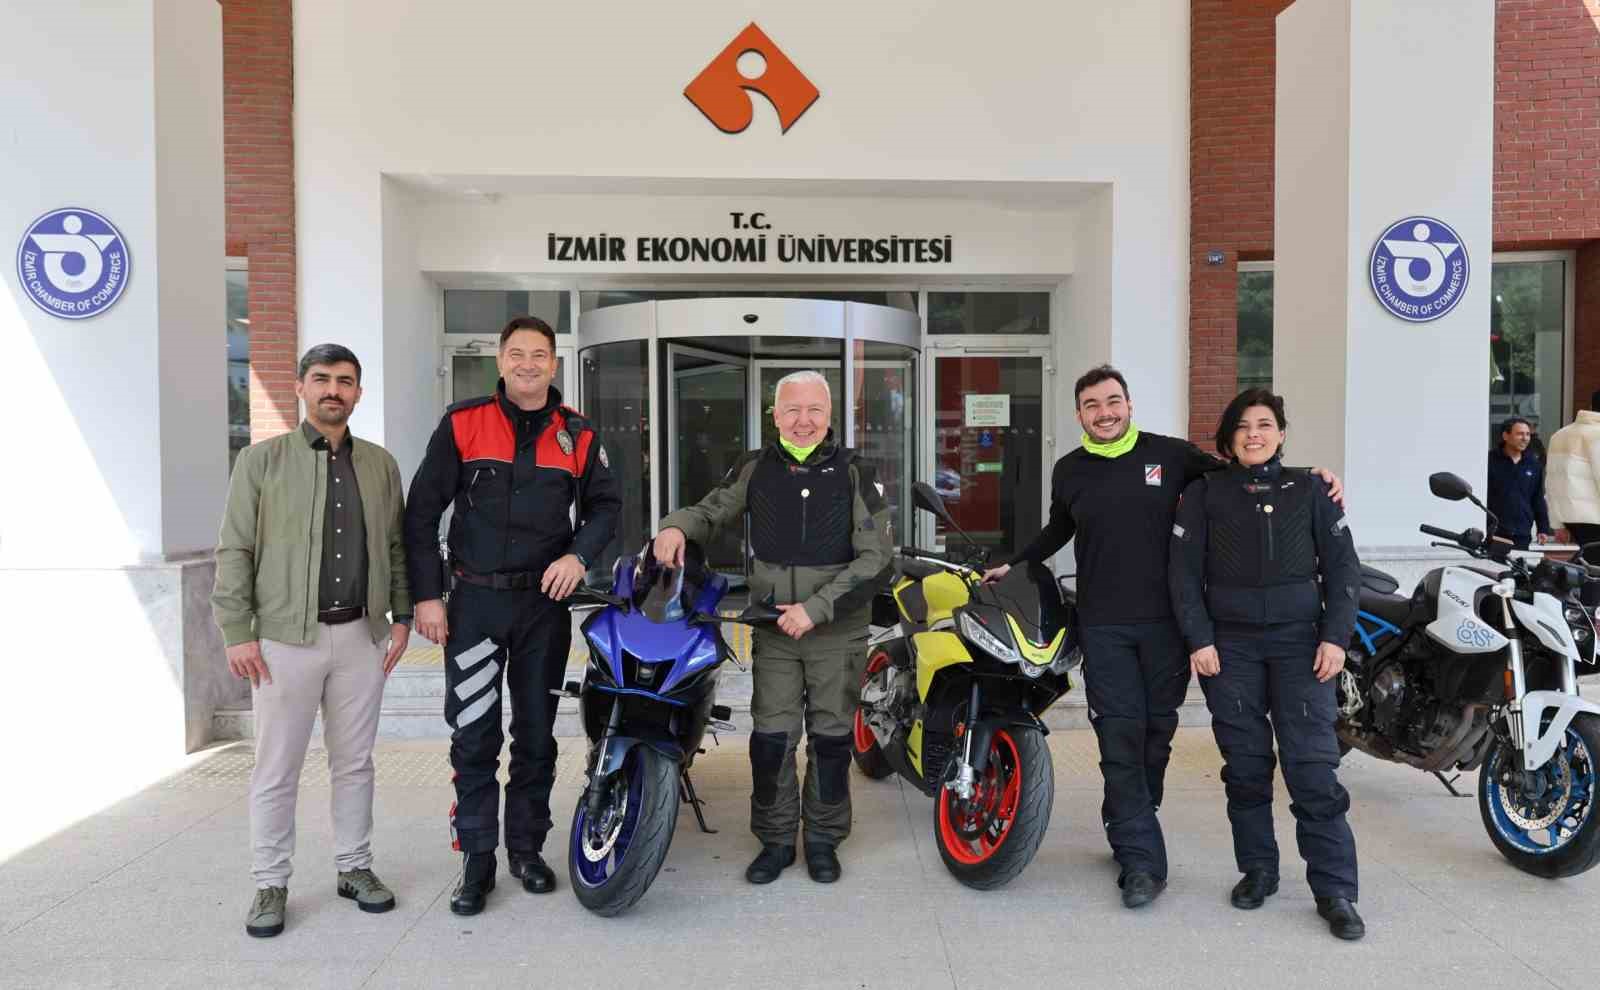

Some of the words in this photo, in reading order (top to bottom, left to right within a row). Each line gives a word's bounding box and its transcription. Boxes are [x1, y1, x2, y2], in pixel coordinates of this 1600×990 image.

[729, 212, 772, 230] T.C.
[547, 233, 626, 262] İZMİR
[637, 234, 767, 263] EKONOMİ
[777, 234, 952, 264] ÜNİVERSİTESİ
[30, 280, 76, 312] CHAMBER
[77, 300, 92, 312] OF
[92, 251, 121, 306] COMMERCE
[1380, 283, 1419, 314] CHAMBER
[1420, 303, 1433, 314] OF
[1433, 259, 1462, 310] COMMERCE
[1443, 589, 1470, 608] SUZUKI
